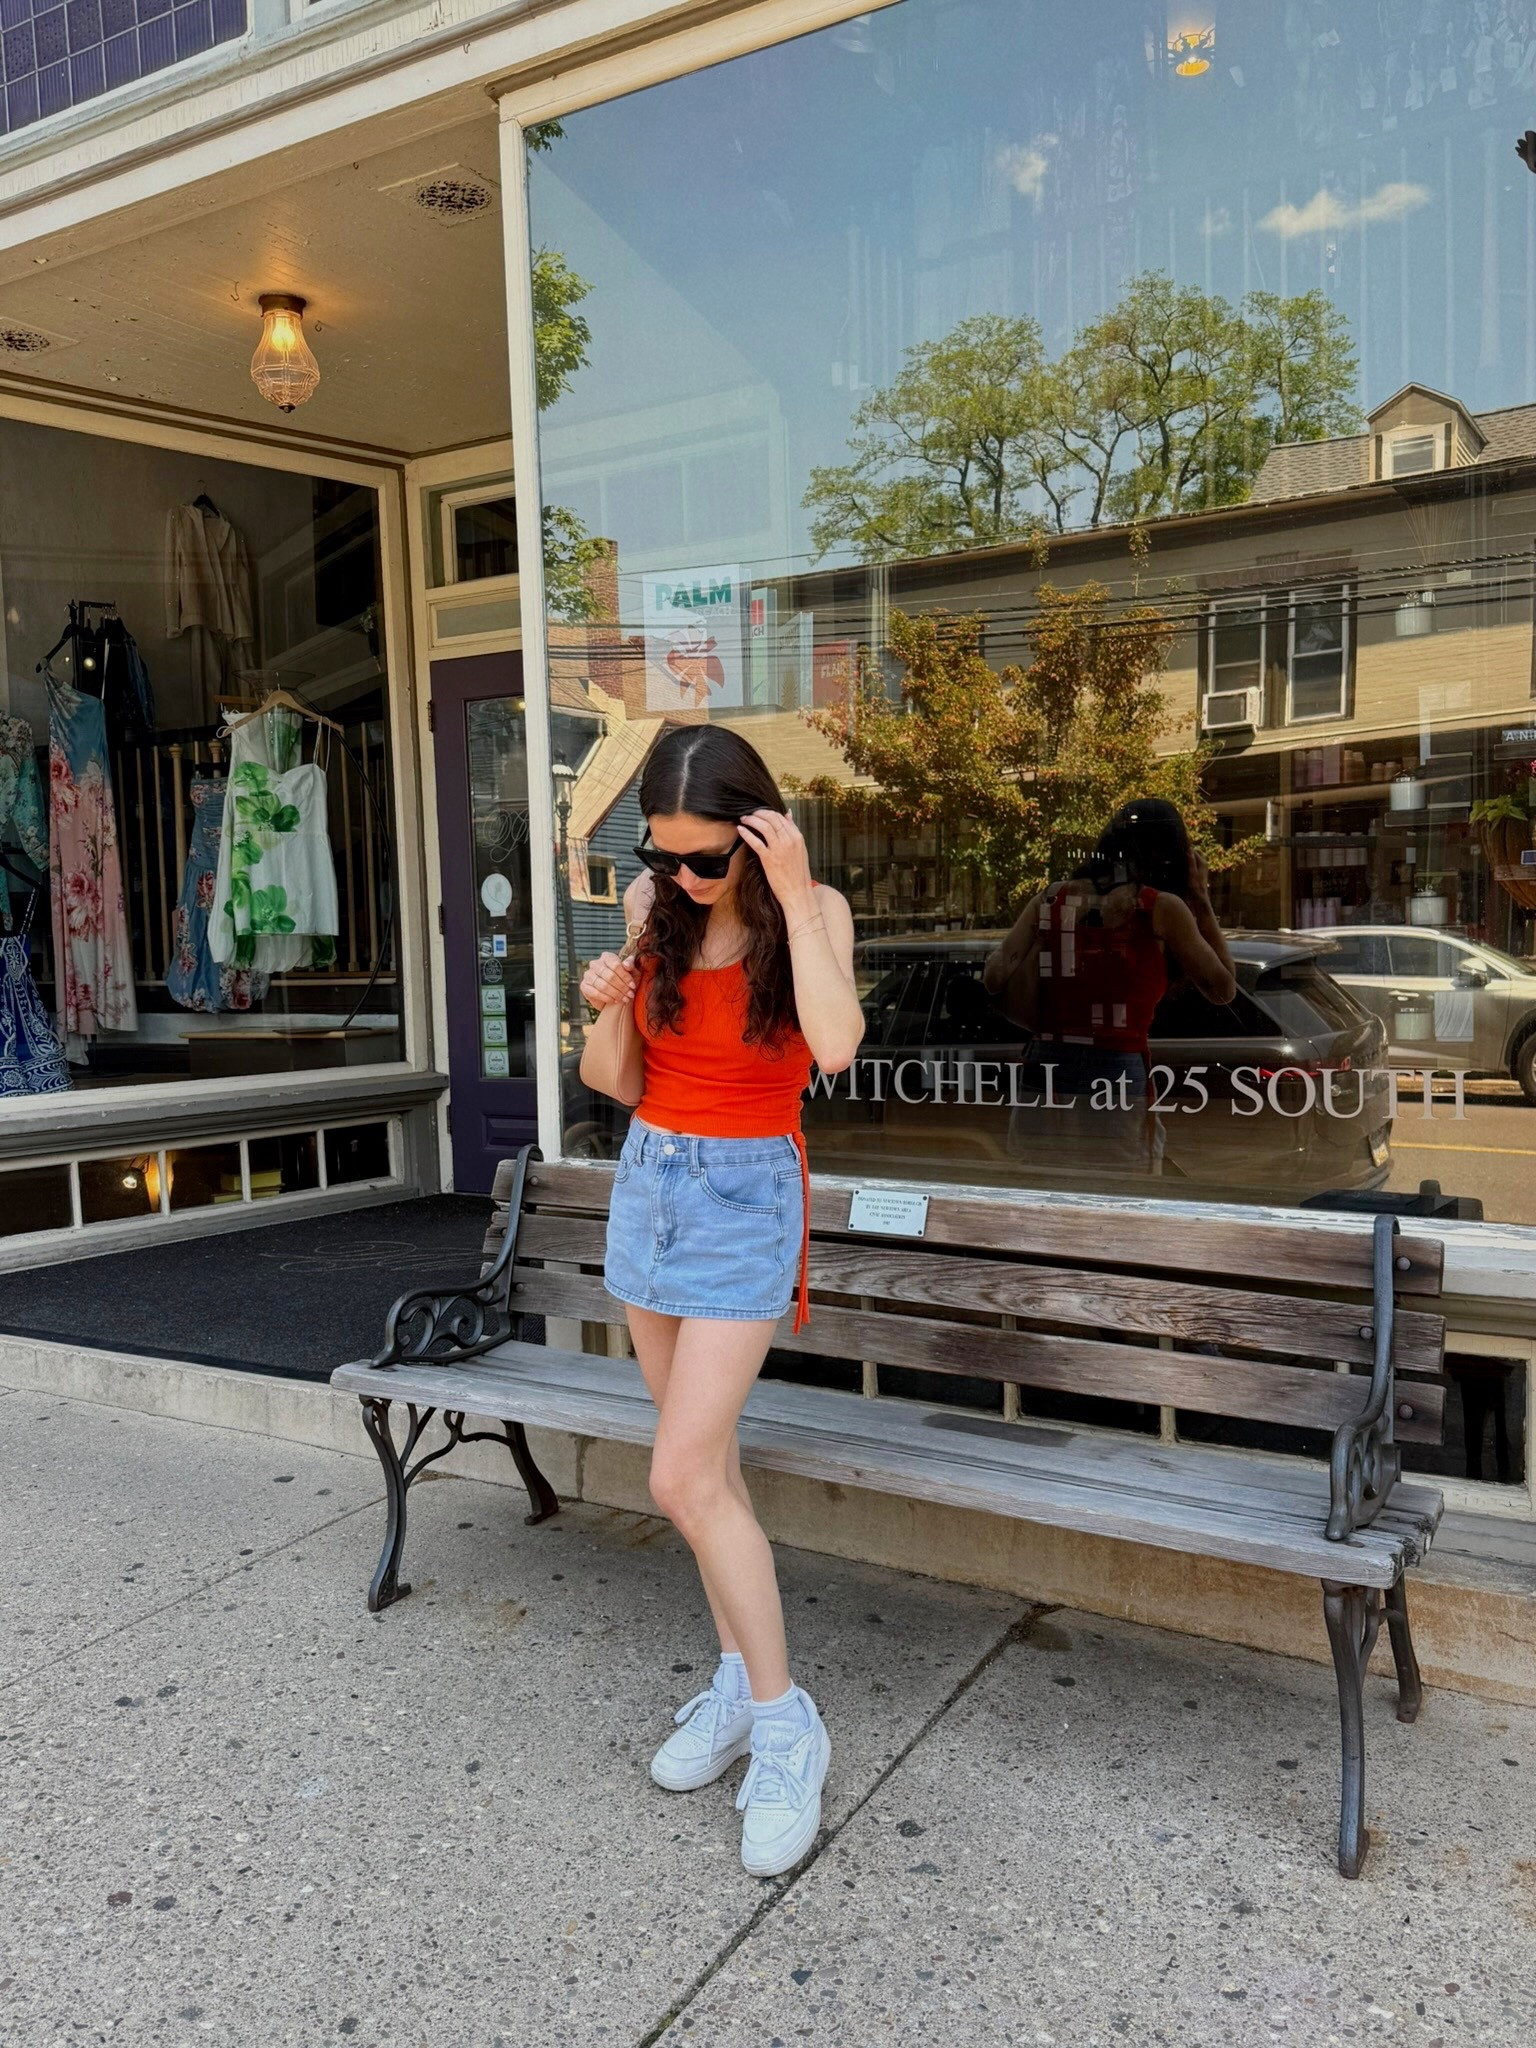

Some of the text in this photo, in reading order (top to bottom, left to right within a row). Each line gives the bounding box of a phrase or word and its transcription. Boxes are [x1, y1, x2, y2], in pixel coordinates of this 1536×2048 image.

[656, 576, 732, 611] PALM
[1090, 1070, 1134, 1111] at
[1148, 1064, 1209, 1113] 25
[1231, 1066, 1472, 1120] SOUTH
